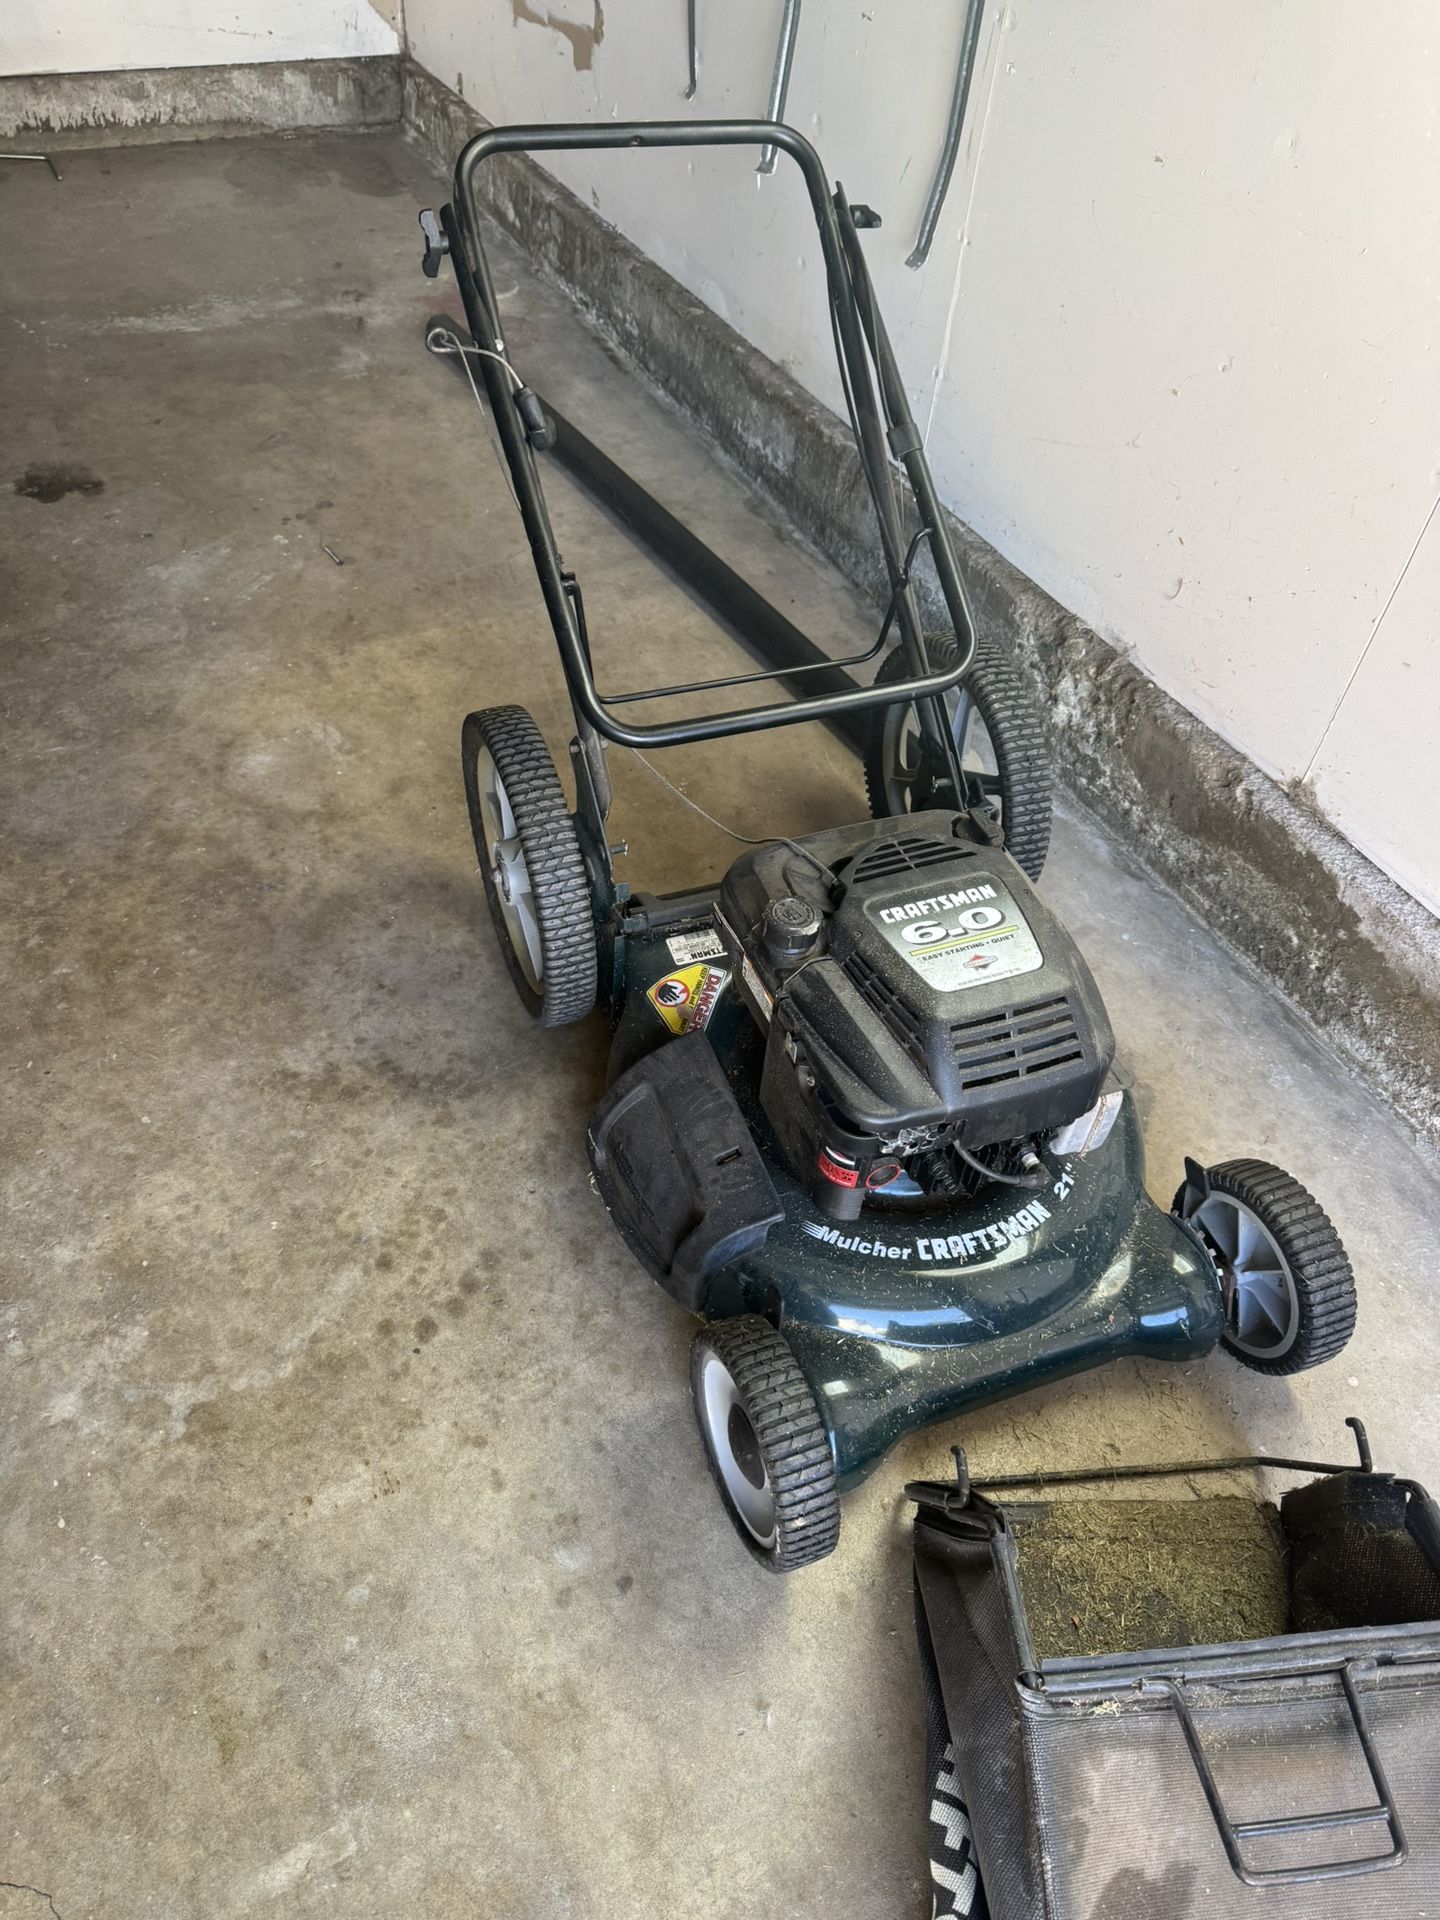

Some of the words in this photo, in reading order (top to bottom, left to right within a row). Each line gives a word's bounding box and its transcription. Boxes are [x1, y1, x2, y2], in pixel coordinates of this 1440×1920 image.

[879, 884, 998, 924] CRAFTSMAN
[901, 906, 1005, 945] 6.0
[922, 953, 943, 962] EASY
[944, 942, 985, 956] STARTING
[991, 933, 1015, 944] QUIET
[700, 967, 708, 979] KEEP
[820, 1226, 912, 1260] Mulcher
[917, 1200, 1051, 1261] CRAFTSMAN
[1053, 1162, 1076, 1201] 21"
